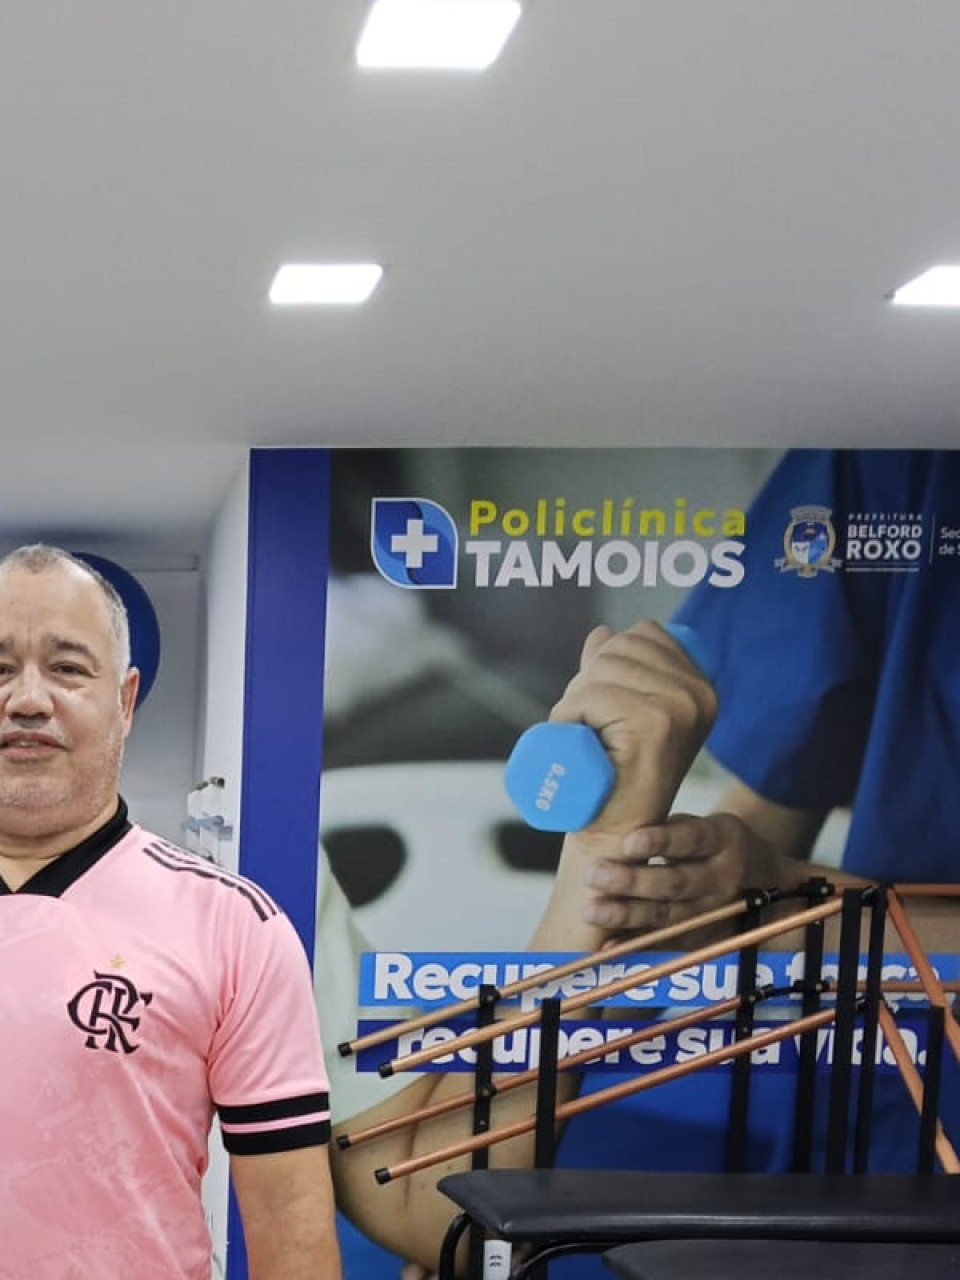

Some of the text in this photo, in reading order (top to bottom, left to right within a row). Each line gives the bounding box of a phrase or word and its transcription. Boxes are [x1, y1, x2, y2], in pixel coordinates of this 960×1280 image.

[470, 498, 745, 537] Policlínica
[847, 524, 923, 539] BELFORD
[466, 540, 745, 588] TAMOIOS
[846, 539, 922, 560] ROXO
[373, 952, 659, 1013] Recupere
